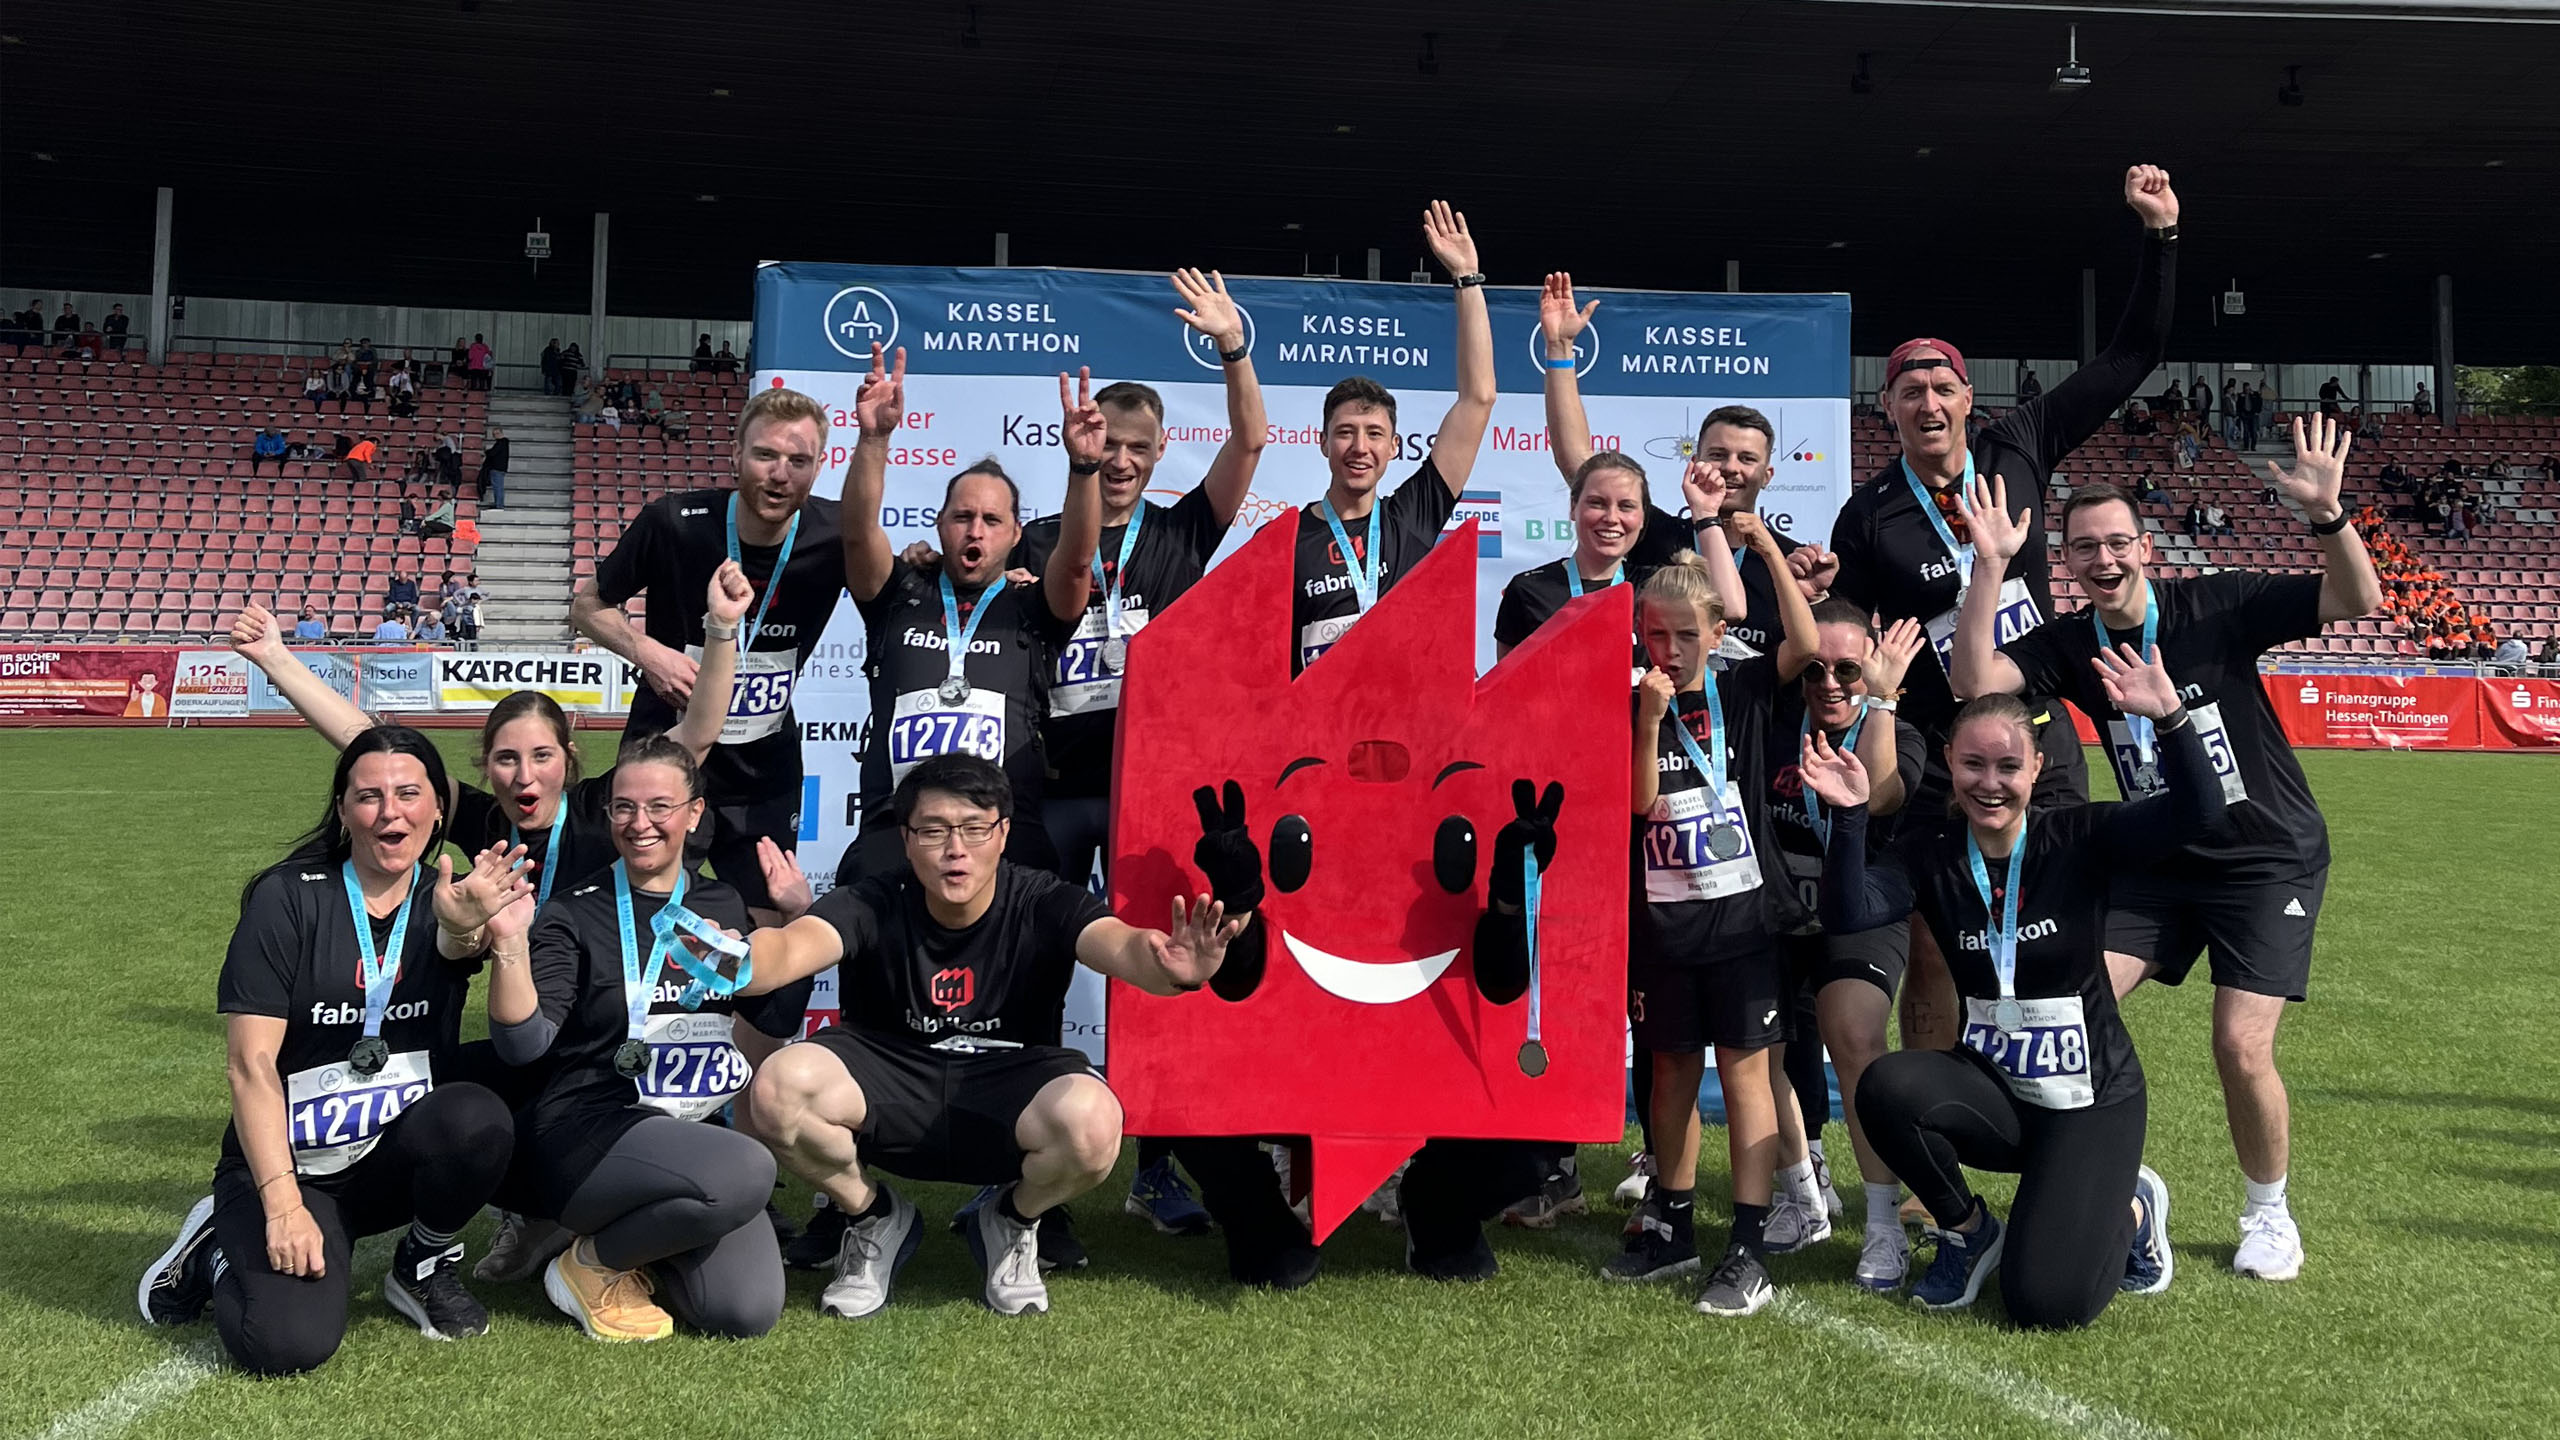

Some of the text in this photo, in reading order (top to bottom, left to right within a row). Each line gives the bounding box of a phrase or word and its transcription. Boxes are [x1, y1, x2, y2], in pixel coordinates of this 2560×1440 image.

[948, 302, 1056, 323] KASSEL
[1302, 315, 1406, 337] KASSEL
[1645, 326, 1747, 346] KASSEL
[924, 331, 1080, 353] MARATHON
[1279, 344, 1429, 367] MARATHON
[1622, 354, 1769, 375] MARATHON
[903, 627, 1001, 655] fabron
[15, 652, 60, 662] SUCHEN
[2, 661, 50, 676] DICH!
[188, 664, 227, 677] 125
[442, 660, 603, 685] KÄRCHER
[179, 677, 246, 687] KELLNER
[2326, 692, 2417, 707] Finanzgruppe
[2326, 709, 2448, 725] Hessen-Thüringen
[894, 715, 1001, 761] 12743
[1958, 918, 2058, 951] fabkon
[311, 1000, 429, 1025] fabrkon
[1969, 1028, 2084, 1075] 12748
[645, 1045, 748, 1094] 12739
